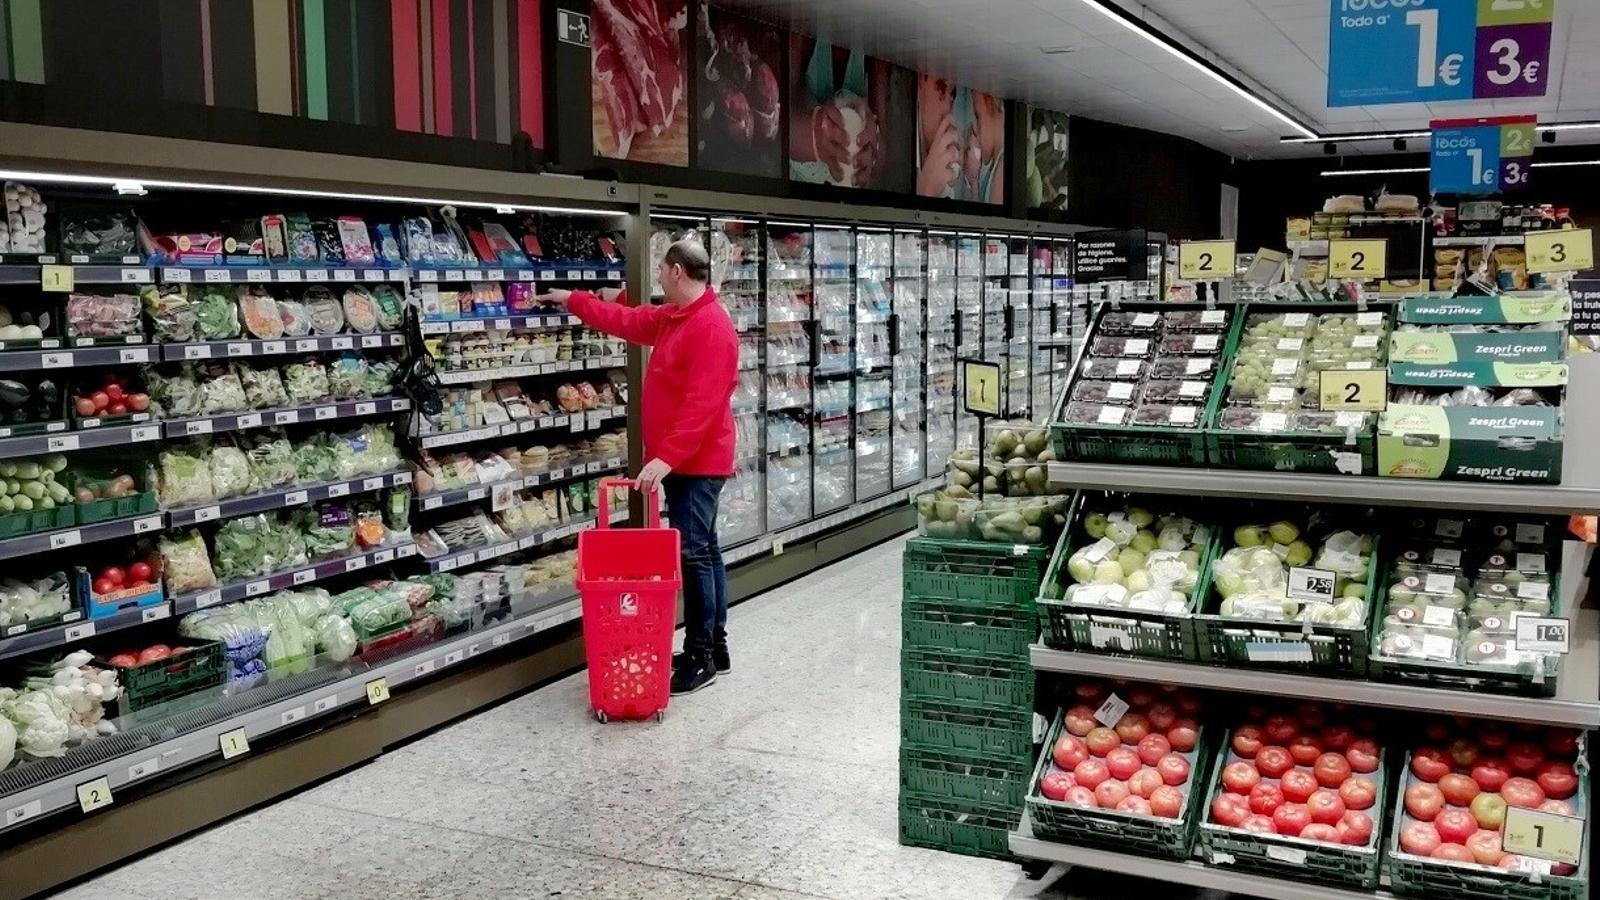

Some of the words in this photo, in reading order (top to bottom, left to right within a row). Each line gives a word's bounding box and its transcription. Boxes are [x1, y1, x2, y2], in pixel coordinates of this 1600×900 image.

[1341, 15, 1373, 28] Todo
[1077, 241, 1089, 249] Por
[1089, 241, 1116, 249] razones
[1077, 249, 1087, 257] de
[1550, 243, 1566, 262] 3
[1077, 256, 1098, 265] utilice
[1199, 252, 1213, 271] 2
[1351, 251, 1365, 270] 2
[1077, 264, 1104, 273] Gracias
[54, 272, 60, 286] 1
[1572, 290, 1582, 299] Te
[1573, 301, 1582, 309] la
[1582, 311, 1591, 319] tu
[1574, 322, 1589, 331] por
[1475, 344, 1512, 355] Zespri
[1513, 345, 1547, 353] Green
[1344, 382, 1361, 403] 2
[1468, 417, 1506, 428] Zespri
[1508, 417, 1545, 427] Green
[1456, 465, 1503, 479] Zespri
[1504, 467, 1549, 478] Green
[231, 738, 238, 749] 1
[91, 790, 101, 804] 2
[1533, 825, 1544, 848] 1
